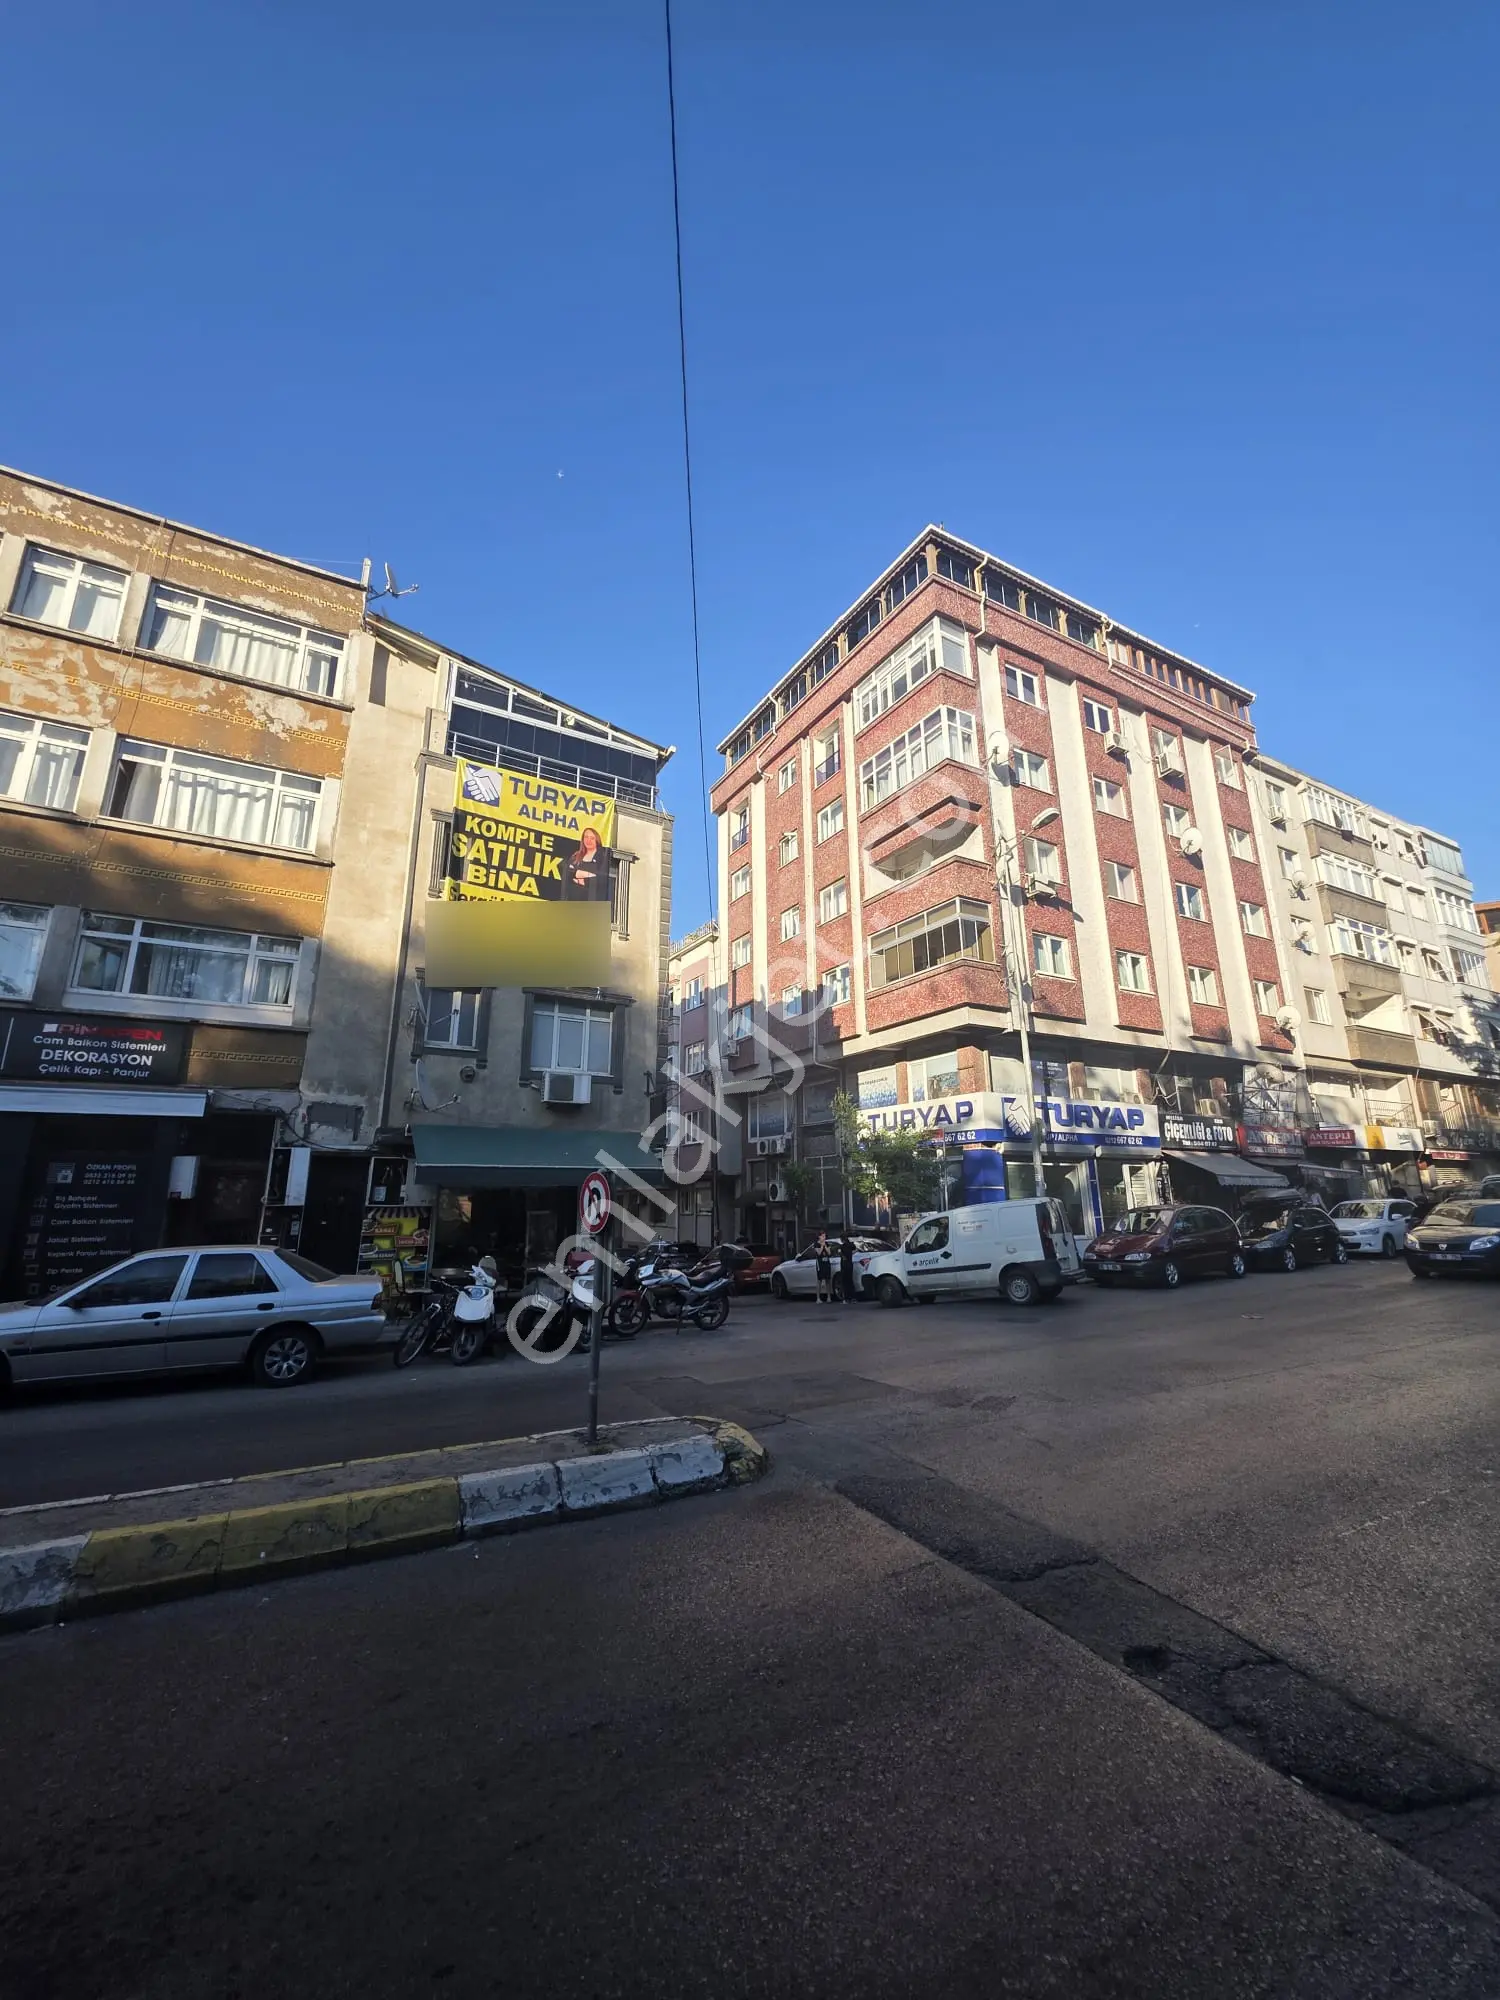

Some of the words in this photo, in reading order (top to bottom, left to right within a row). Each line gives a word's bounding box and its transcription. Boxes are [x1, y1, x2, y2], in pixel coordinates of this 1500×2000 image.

[508, 775, 606, 817] TURYAP
[517, 804, 579, 831] ALPHA
[465, 815, 555, 852] KOMPLE
[452, 832, 564, 881] SATILIK
[33, 1035, 64, 1045] Cam
[67, 1037, 107, 1048] Balkon
[111, 1040, 166, 1052] Sistemleri
[38, 1063, 72, 1074] Çelik
[113, 1067, 151, 1078] Panjur
[40, 1049, 153, 1066] DEKORASYON
[867, 1100, 974, 1133] TURYAP
[1034, 1102, 1144, 1130] TURYAP
[957, 1131, 966, 1141] 62
[966, 1130, 976, 1140] 62
[1206, 1127, 1213, 1140] &
[1213, 1126, 1233, 1142] FOTO
